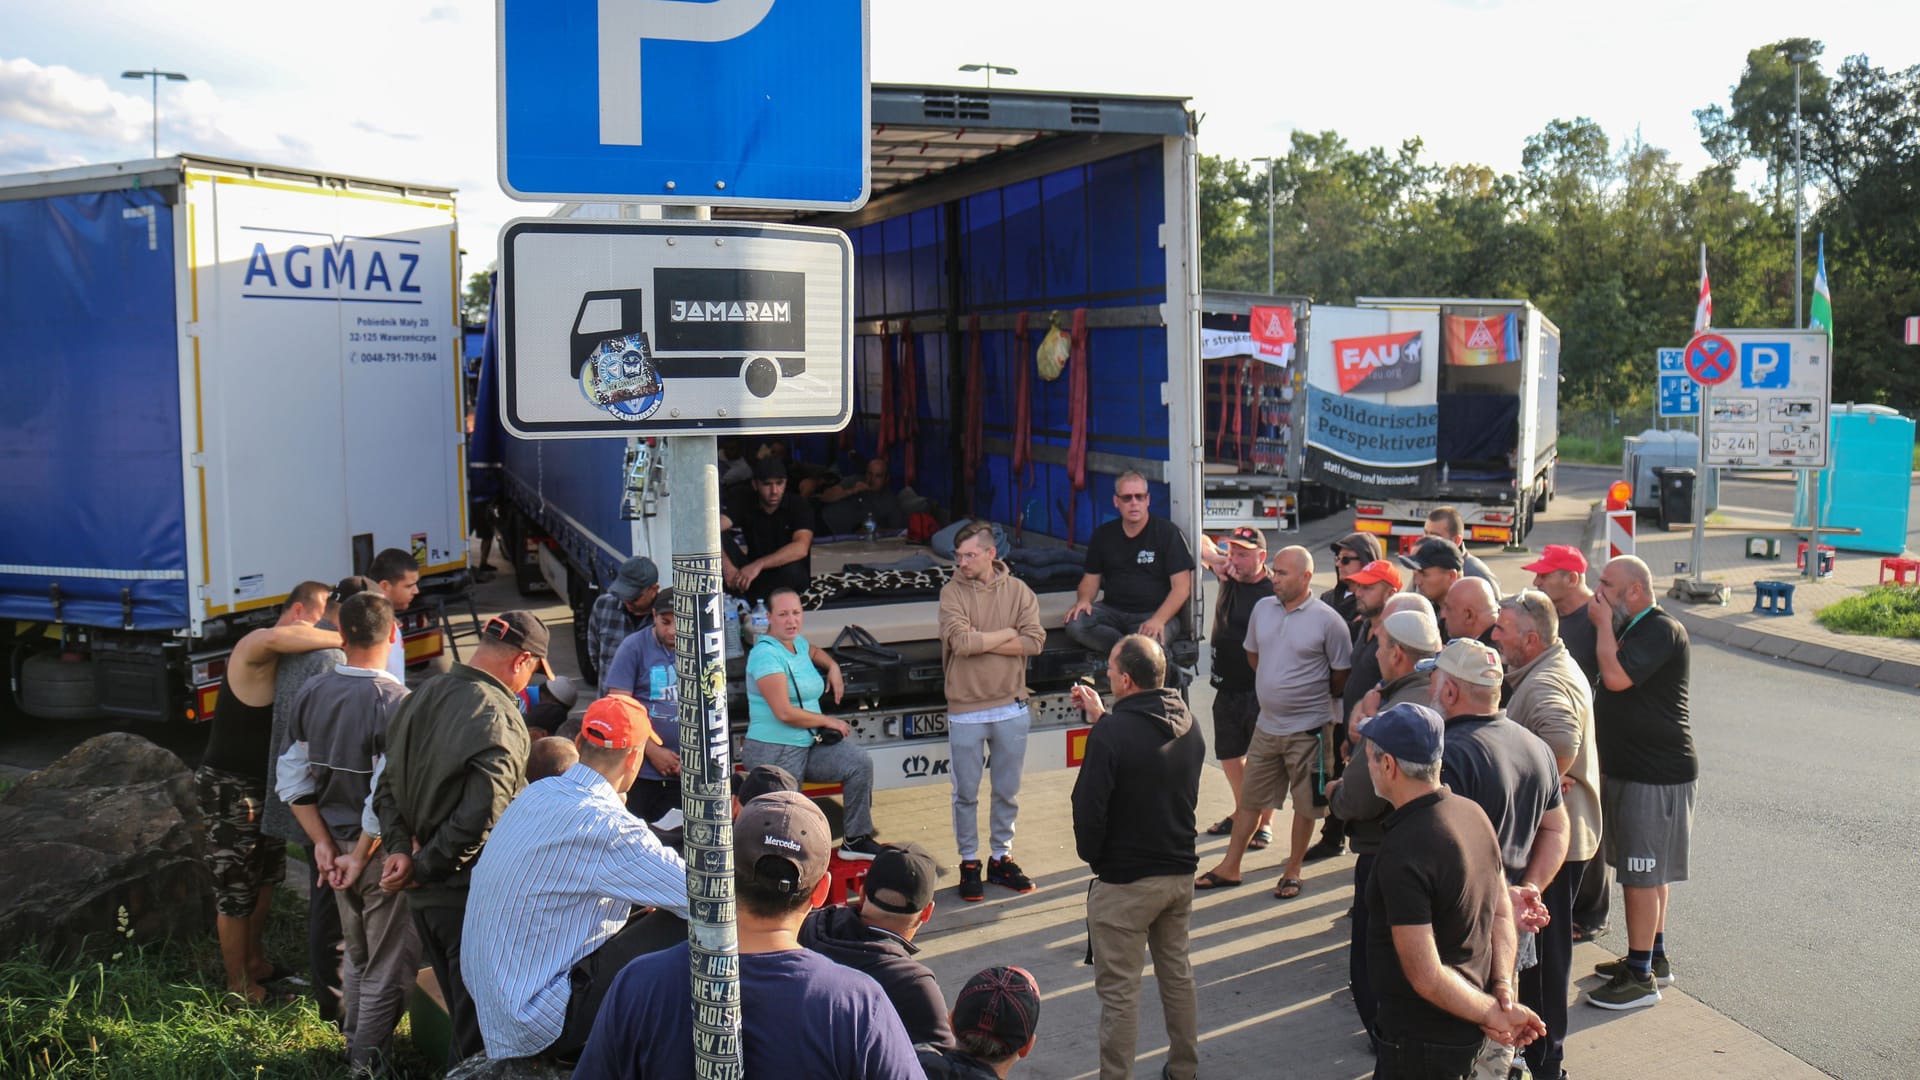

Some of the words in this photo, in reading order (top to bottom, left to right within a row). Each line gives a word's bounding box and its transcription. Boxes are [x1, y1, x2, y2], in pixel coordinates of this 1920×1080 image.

[244, 242, 421, 293] AGMAZ
[357, 317, 397, 326] Pobiednik
[420, 318, 429, 327] 20
[671, 301, 789, 322] JAMARAM
[349, 333, 377, 342] 32-125
[361, 352, 437, 363] 0048-791-791-594
[1342, 344, 1400, 369] FAU
[1752, 347, 1779, 384] P
[1321, 397, 1437, 429] Solidarische
[1318, 416, 1437, 451] Perspektiven
[914, 714, 944, 733] KNS
[764, 835, 801, 852] Mercedes
[1627, 856, 1656, 873] IUP
[694, 977, 725, 1002] NEW
